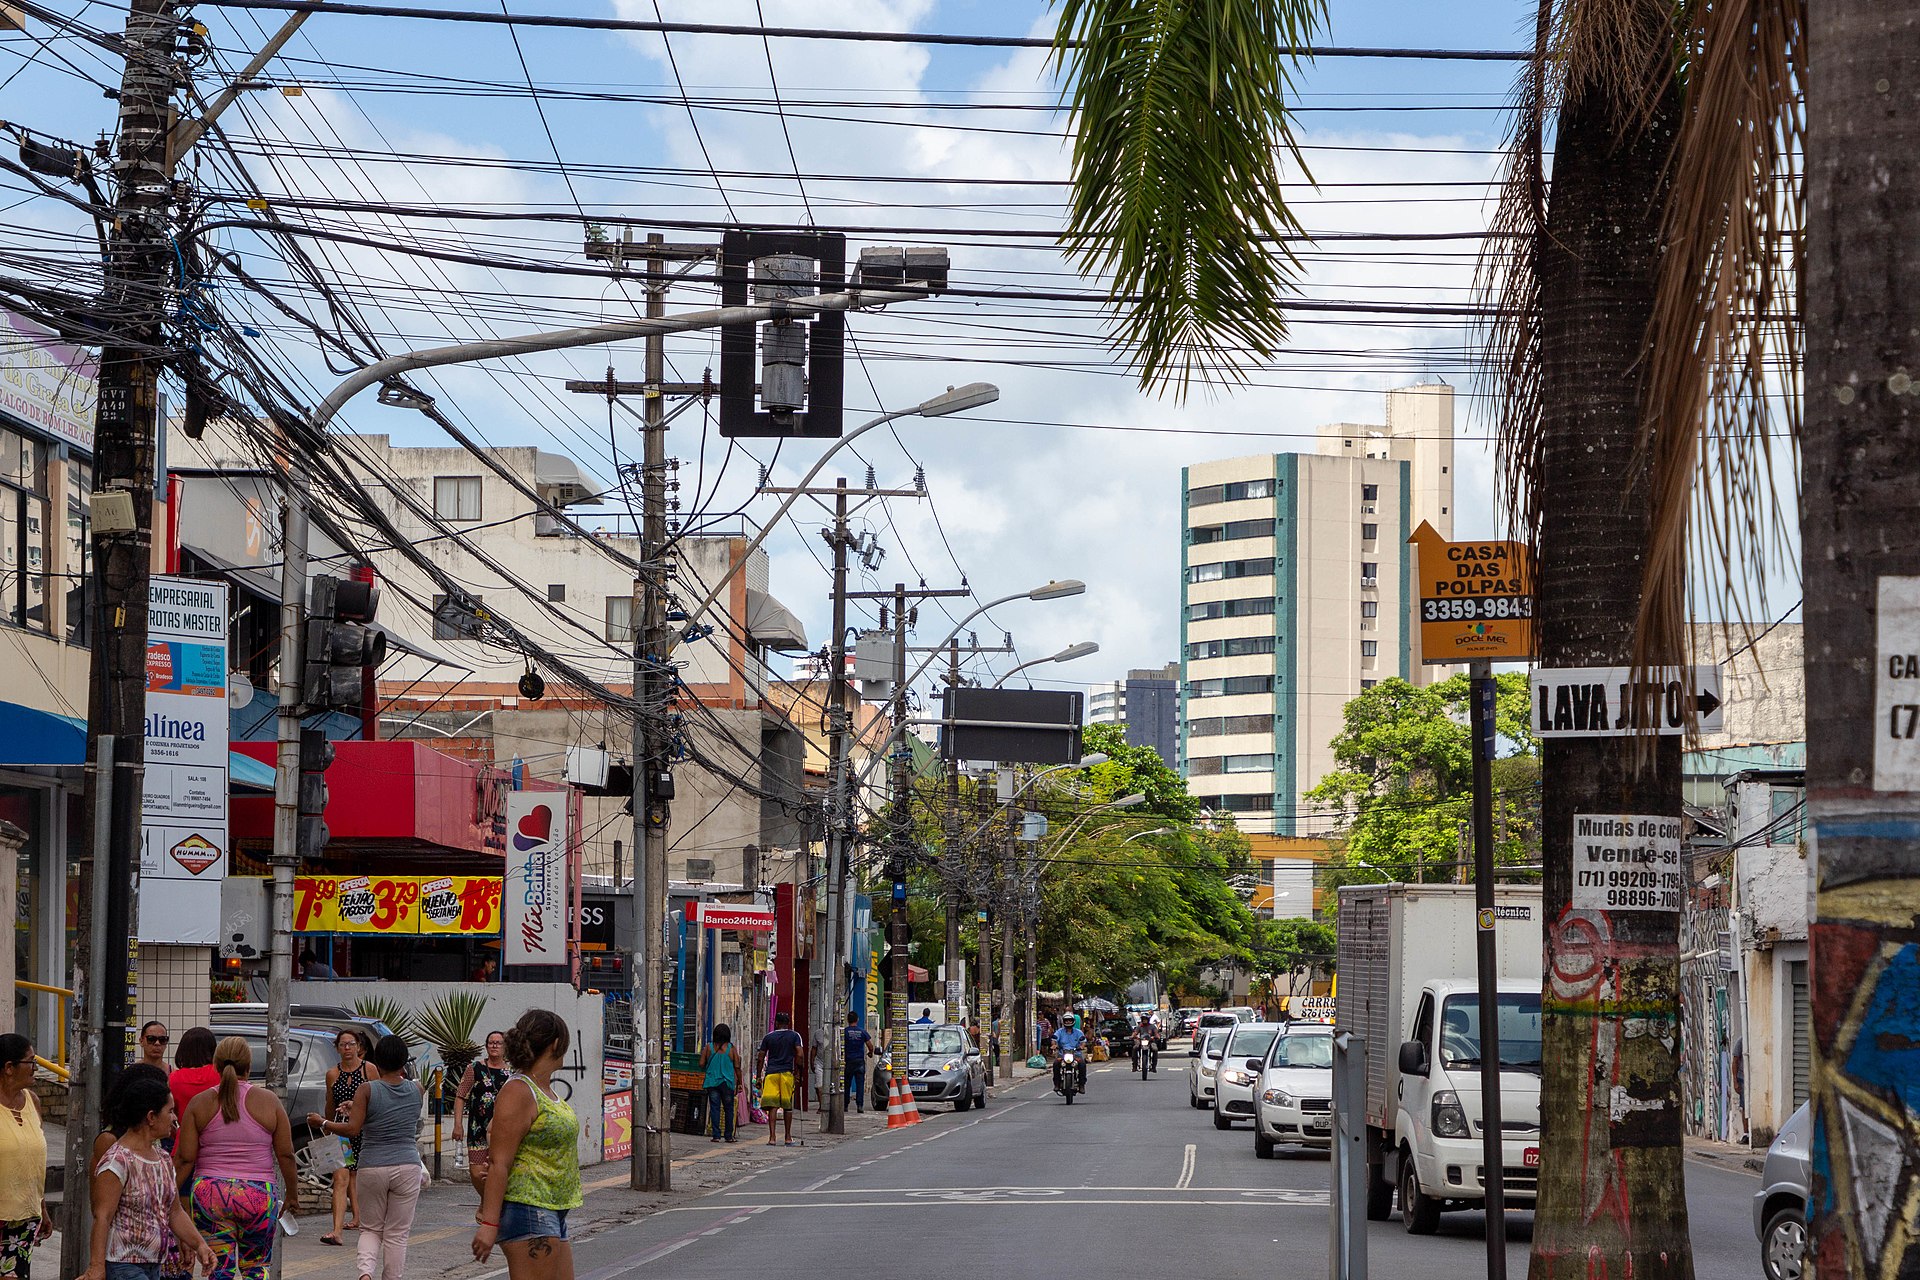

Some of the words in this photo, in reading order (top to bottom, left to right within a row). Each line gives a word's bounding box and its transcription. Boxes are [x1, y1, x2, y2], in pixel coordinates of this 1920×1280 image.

[4, 391, 28, 416] ALGO
[29, 403, 41, 423] DE
[62, 419, 79, 440] LHE
[1447, 545, 1509, 562] CASA
[1456, 562, 1501, 578] DAS
[1435, 578, 1521, 596] POLPAS
[149, 586, 215, 609] EMPRESARIAL
[183, 612, 221, 633] MASTER
[1455, 635, 1484, 645] DOCE
[1486, 635, 1508, 644] MEL
[147, 651, 171, 661] radesco
[1539, 683, 1609, 731] LAVA
[1578, 819, 1635, 837] Mudas
[1638, 820, 1656, 838] de
[1586, 845, 1678, 865] Vende-se
[339, 876, 370, 892] OFERTA
[421, 877, 453, 895] OFERTA
[1578, 871, 1605, 887] (71)
[705, 915, 773, 926] Banco24Horas
[611, 1110, 627, 1119] em
